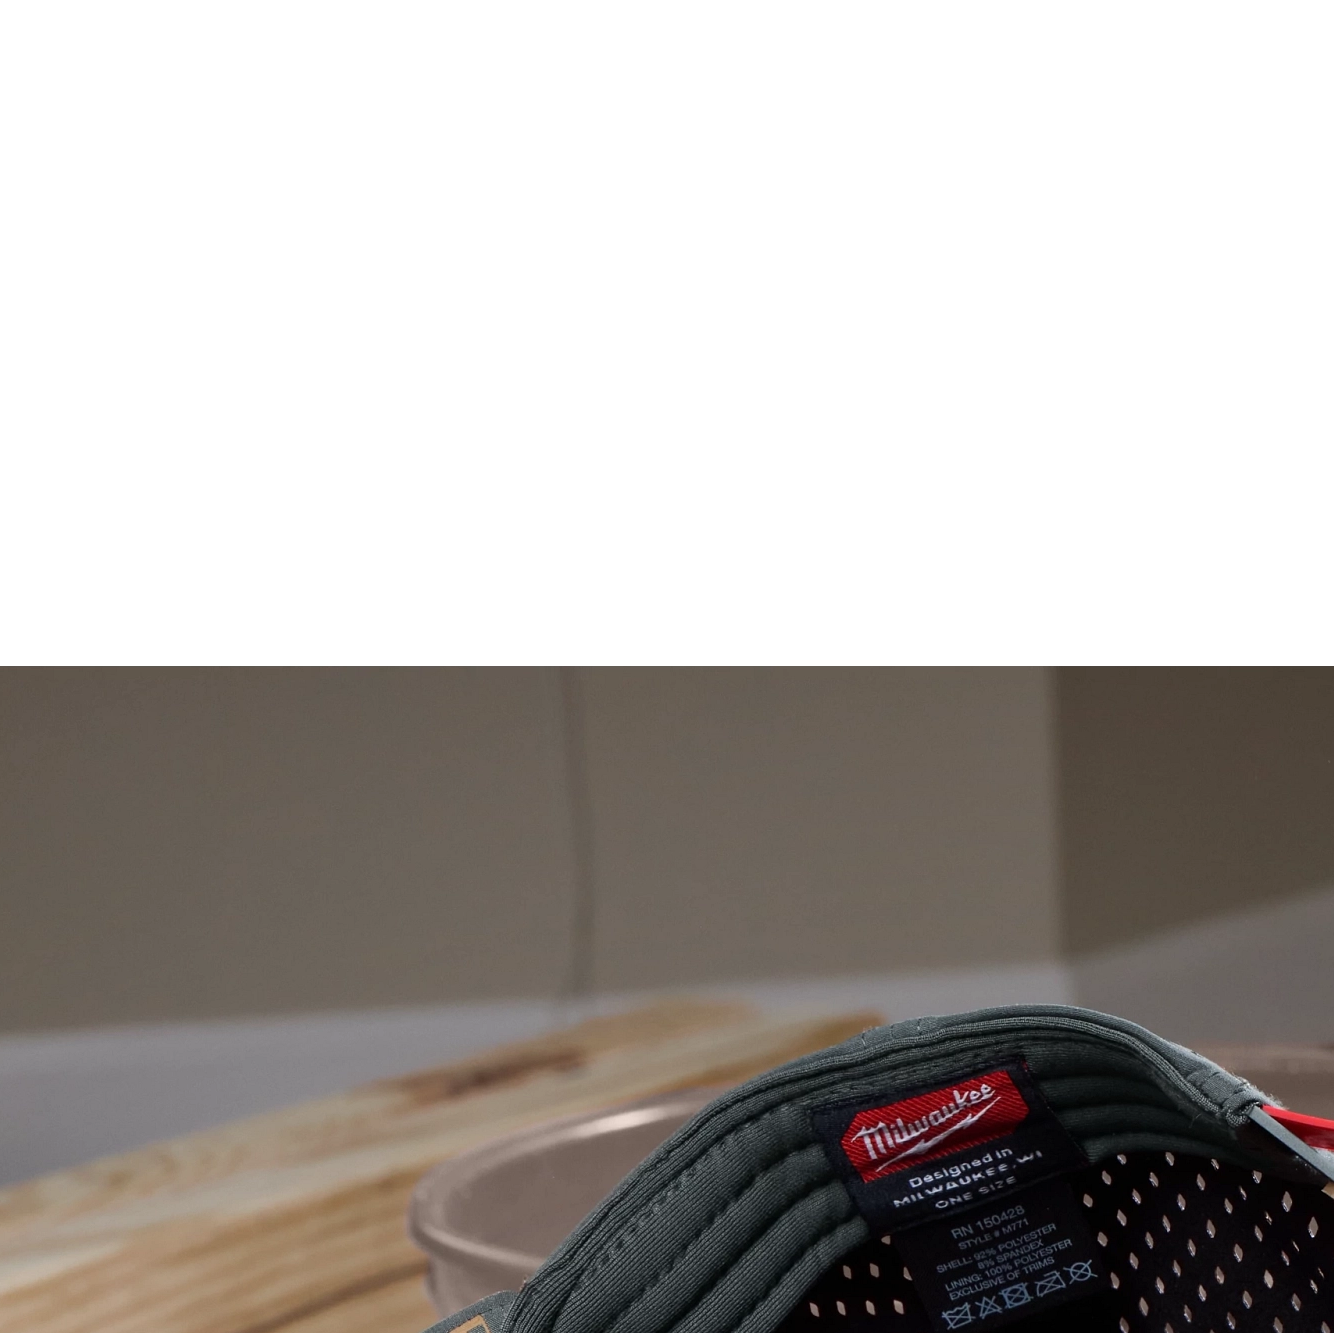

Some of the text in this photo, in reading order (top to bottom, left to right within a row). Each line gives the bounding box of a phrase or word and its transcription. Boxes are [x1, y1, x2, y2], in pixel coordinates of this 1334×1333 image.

[851, 1083, 997, 1160] Milwaukee
[909, 1153, 993, 1188] Designed
[1016, 1150, 1043, 1163] WI
[935, 1175, 1016, 1209] ONE SIZE
[951, 1205, 1025, 1239] RN 150428
[936, 1223, 1057, 1273] SHELL: 92% POLYESTER
[958, 1234, 992, 1250] STYLE
[978, 1239, 1044, 1269] 8% SPANDEX
[945, 1239, 1073, 1291] LINING: 100% POLYESTER
[949, 1256, 1055, 1301] EXCLUSIVE OF TRIMS
